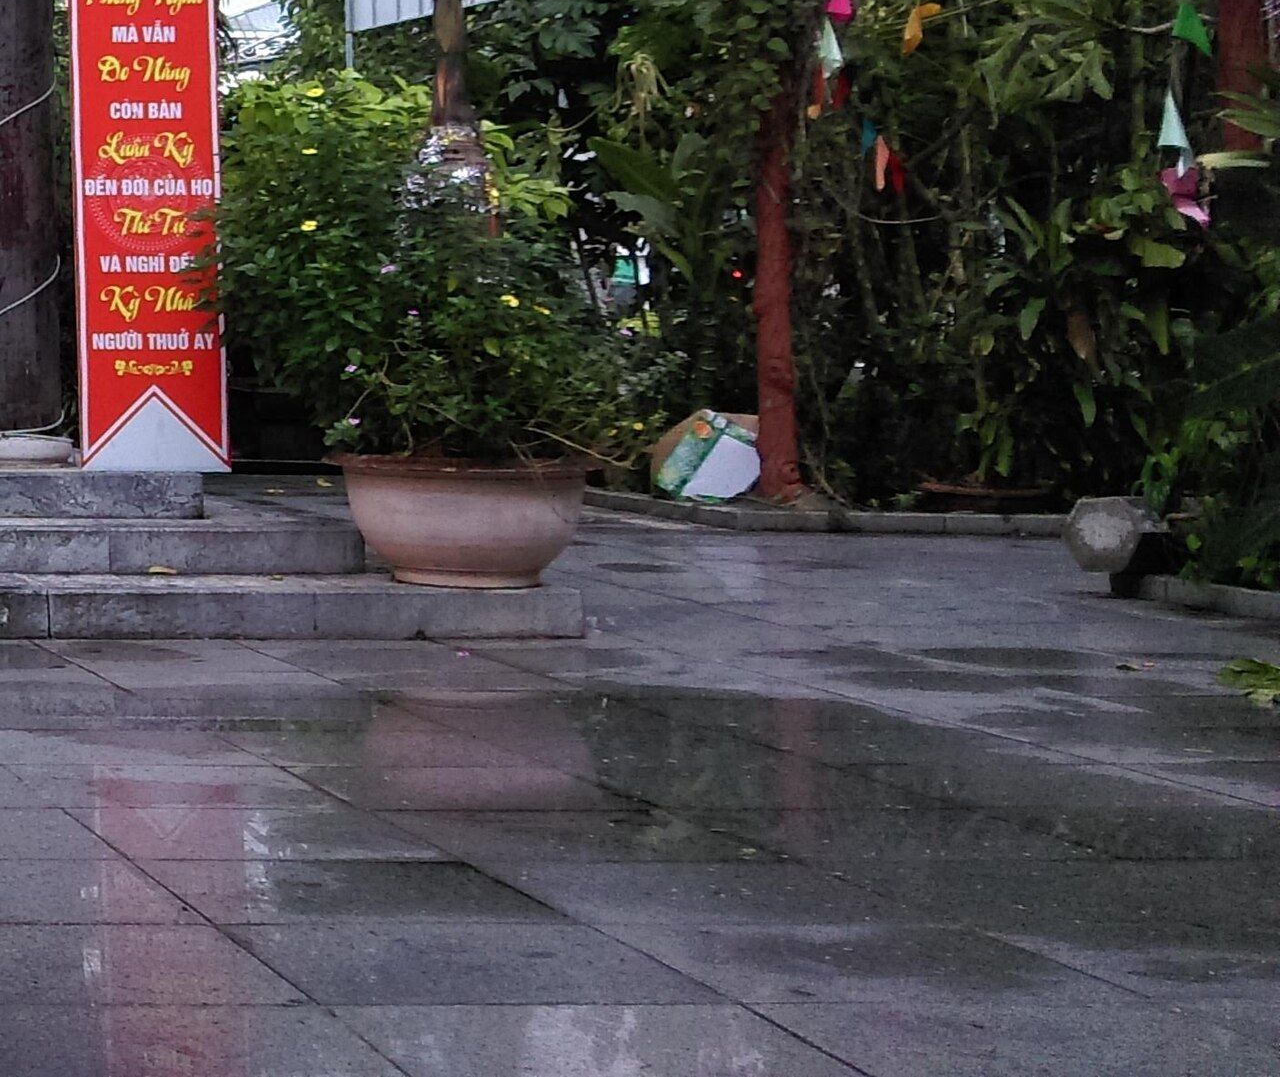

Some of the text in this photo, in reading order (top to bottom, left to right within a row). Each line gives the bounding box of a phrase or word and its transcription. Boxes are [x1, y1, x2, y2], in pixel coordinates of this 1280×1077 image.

[111, 21, 139, 43] MÀ
[109, 98, 144, 120] CÒN
[168, 254, 198, 273] ĐẾ
